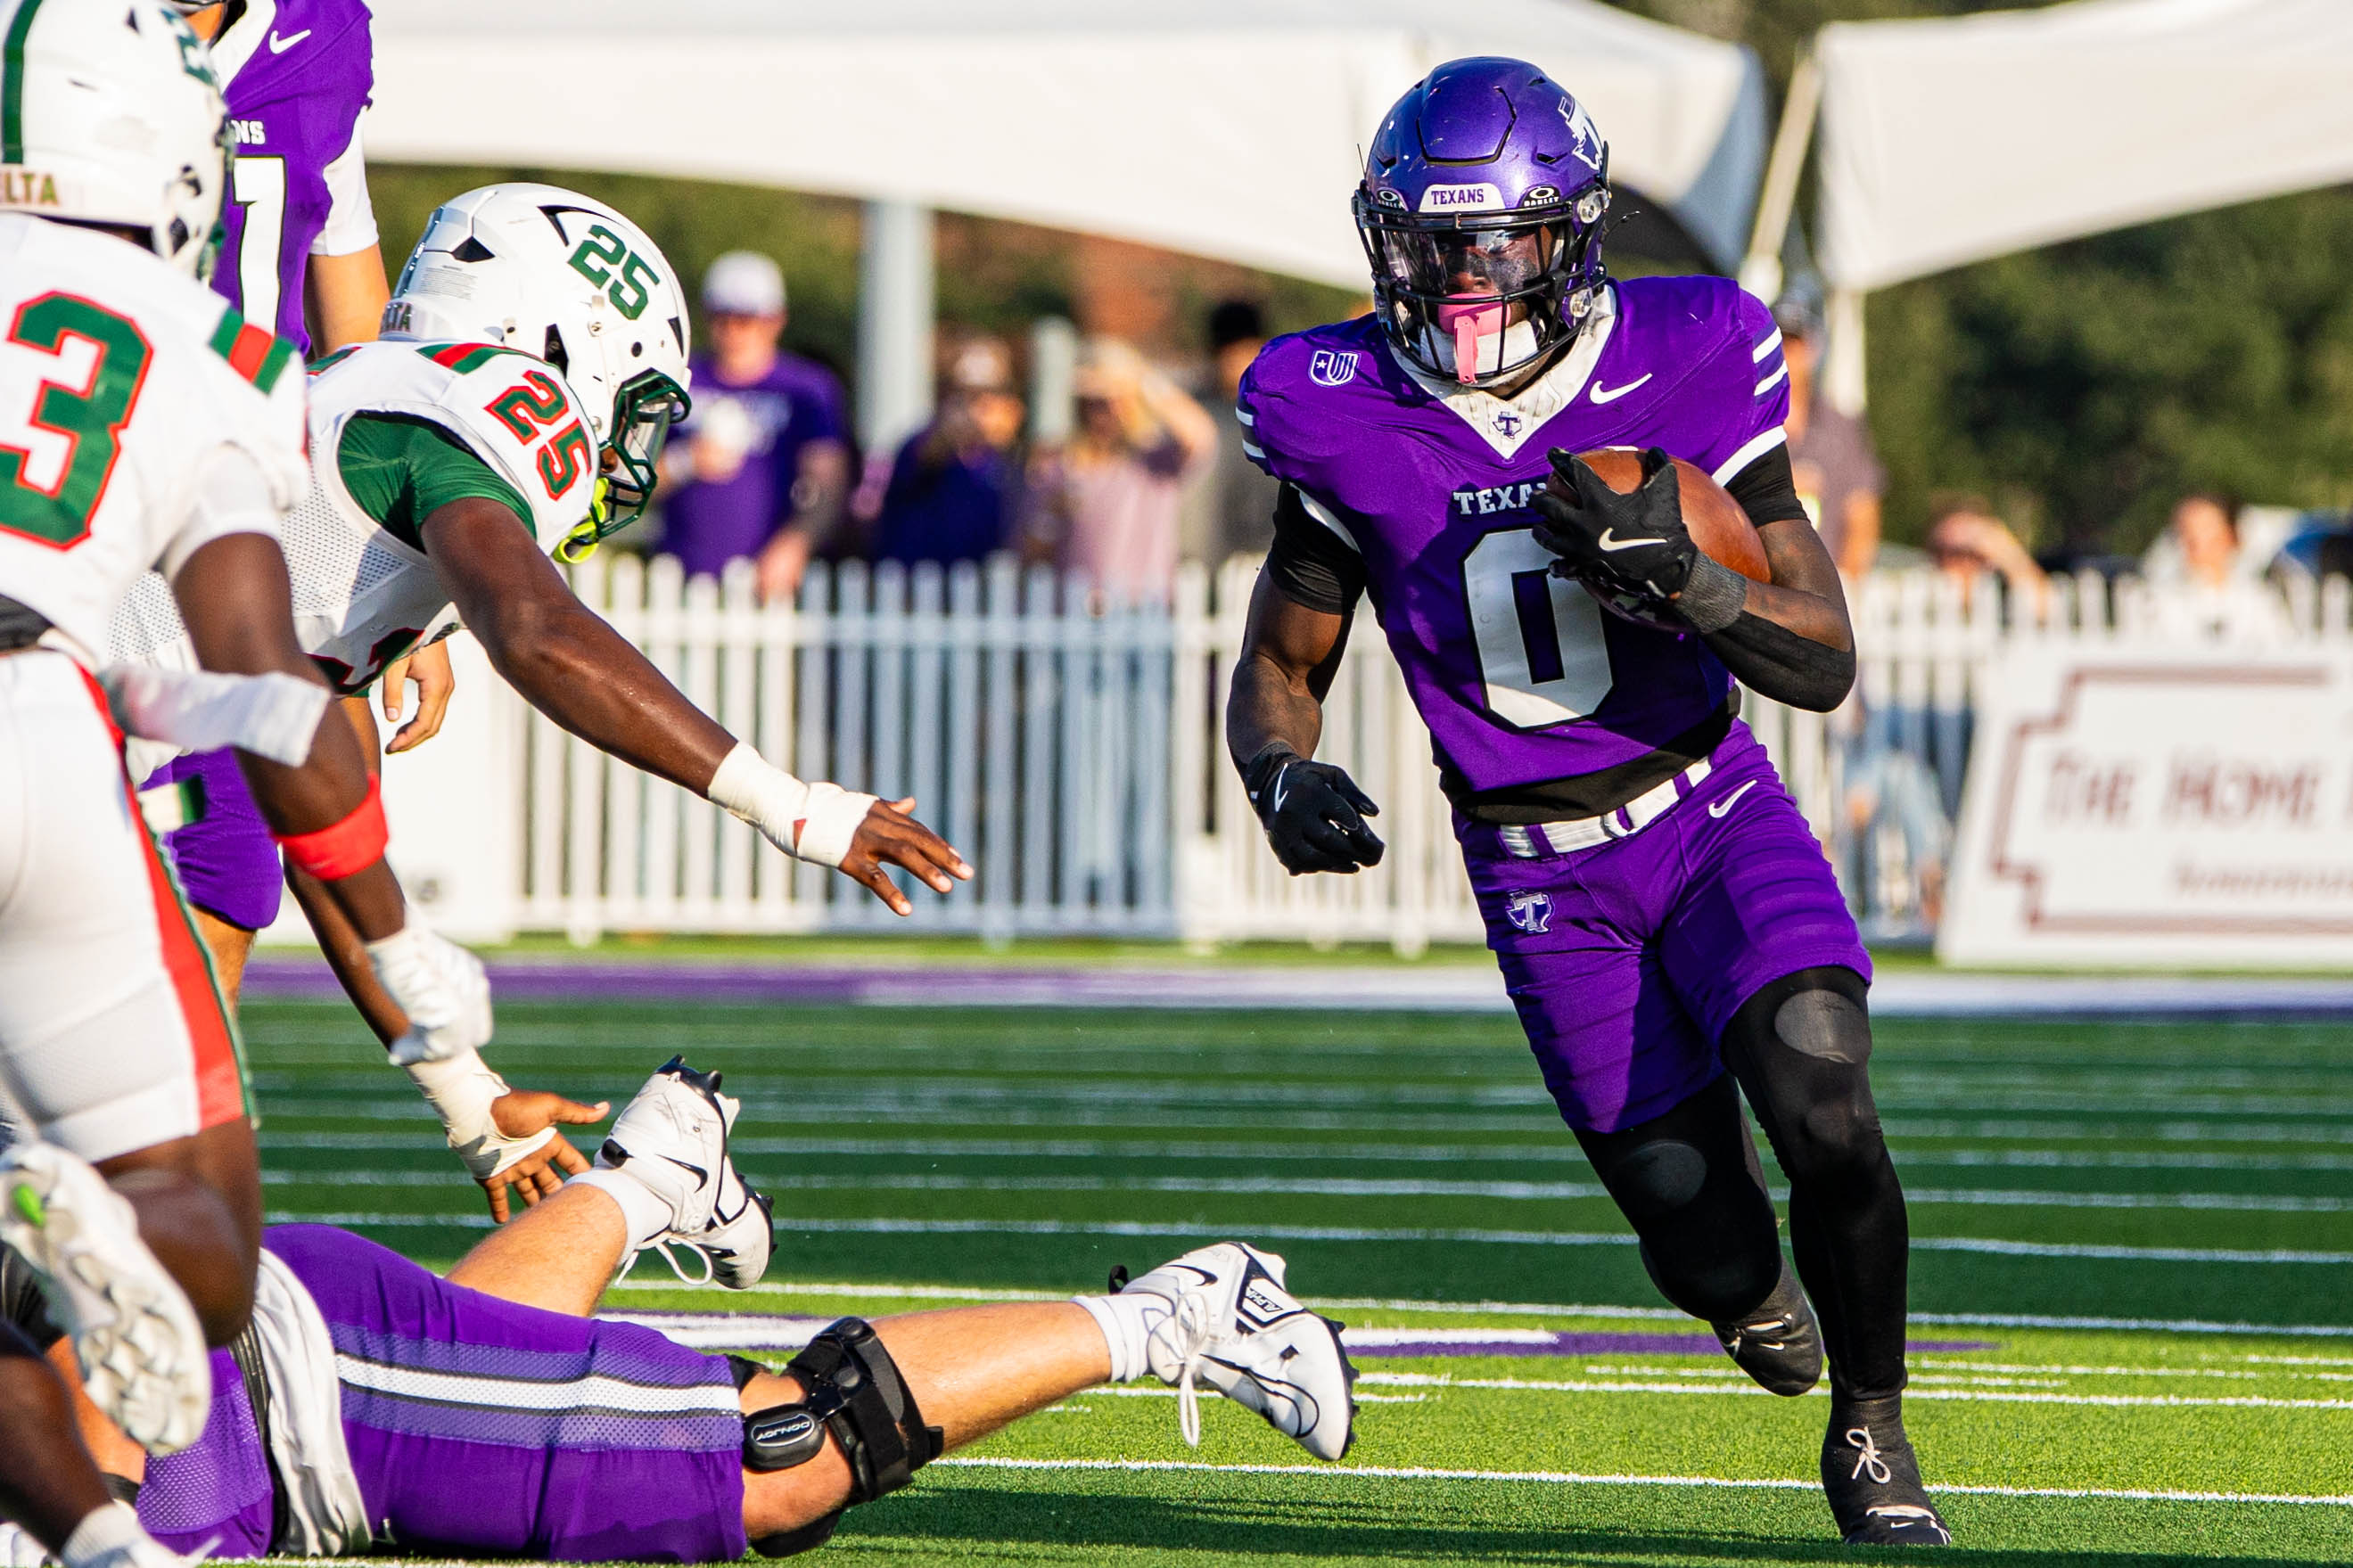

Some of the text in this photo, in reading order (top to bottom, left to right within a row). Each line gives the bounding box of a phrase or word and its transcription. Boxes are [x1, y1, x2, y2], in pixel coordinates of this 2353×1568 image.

[230, 119, 266, 144] NS
[0, 172, 59, 206] LTA
[1431, 188, 1485, 205] TEXANS
[567, 224, 661, 321] 25
[0, 290, 154, 553] 3
[483, 369, 593, 502] 25
[1452, 482, 1547, 514] TEXA
[1460, 527, 1614, 730] 0
